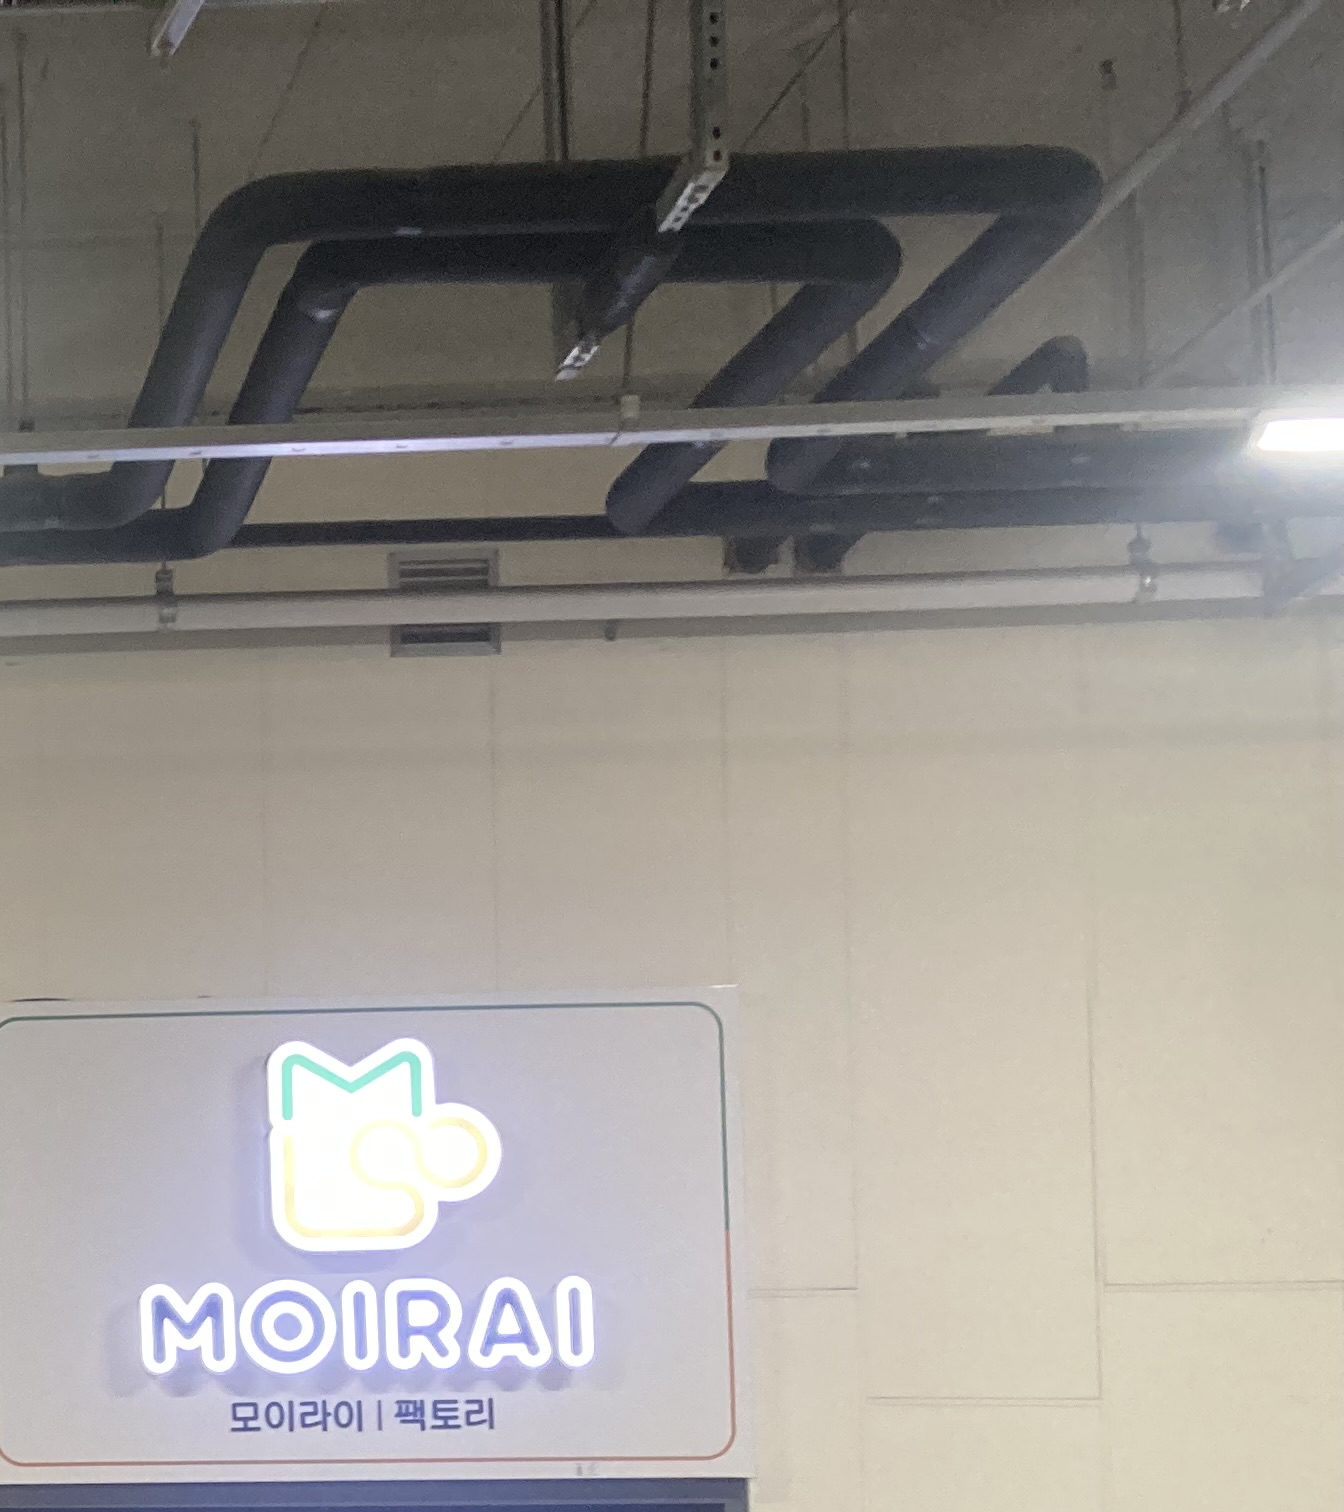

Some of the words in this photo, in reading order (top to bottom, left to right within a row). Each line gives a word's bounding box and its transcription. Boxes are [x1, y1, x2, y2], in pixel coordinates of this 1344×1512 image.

[140, 1275, 595, 1375] MOIRAI
[230, 1399, 363, 1432] 모이라이
[394, 1398, 495, 1431] 팩토리
